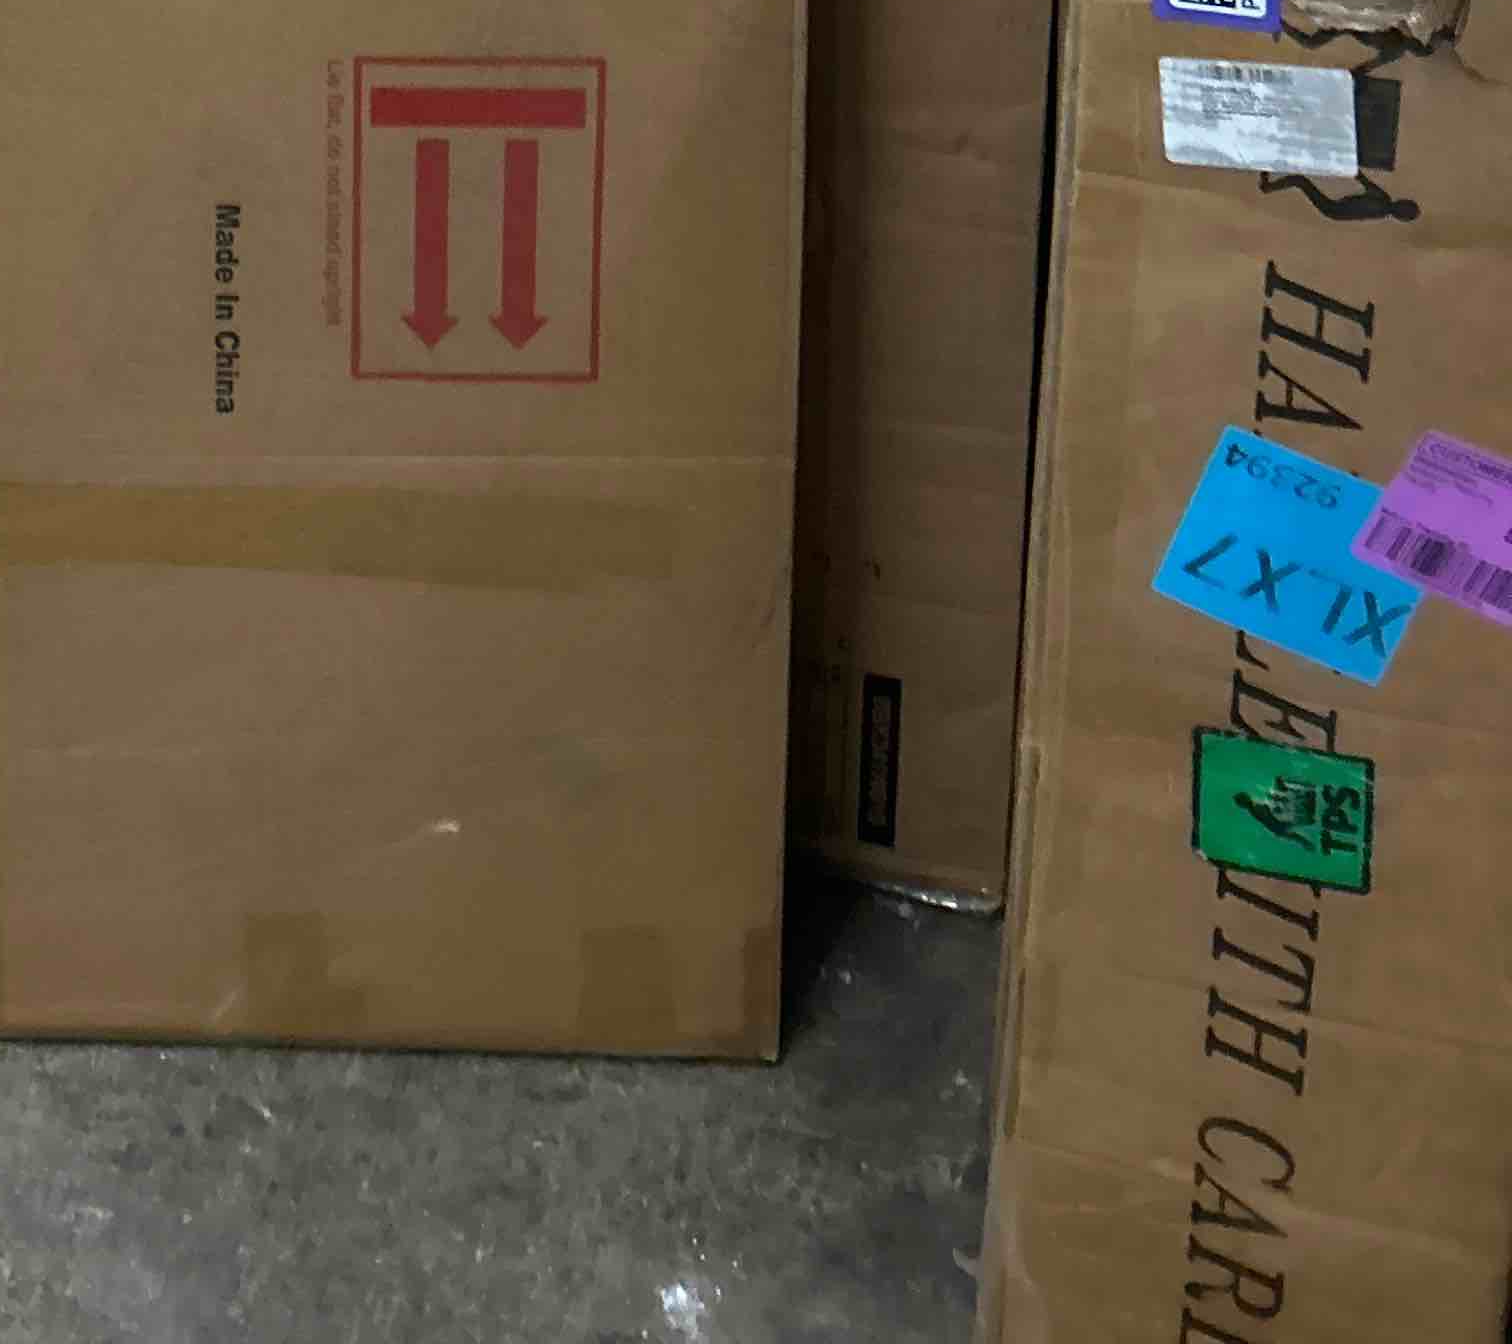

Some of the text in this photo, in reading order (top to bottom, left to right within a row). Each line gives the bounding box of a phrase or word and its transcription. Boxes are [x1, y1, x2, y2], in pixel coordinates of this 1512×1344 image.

[214, 204, 241, 416] Made In China
[1319, 784, 1361, 856] TPS
